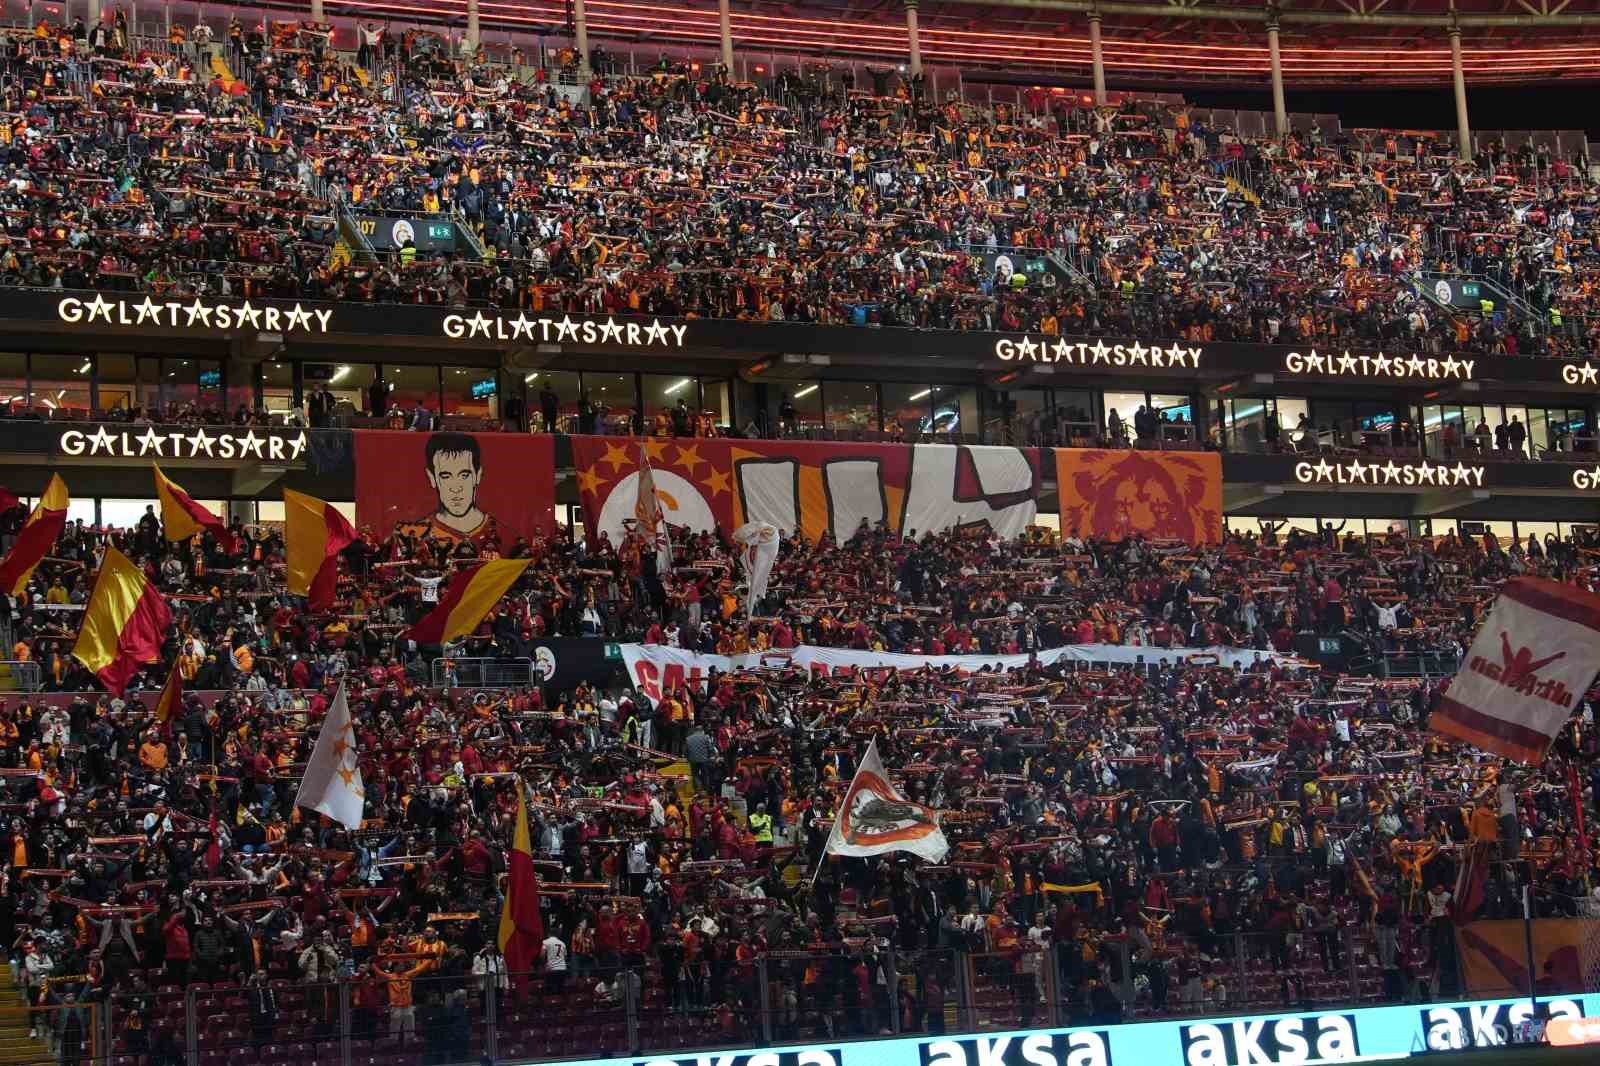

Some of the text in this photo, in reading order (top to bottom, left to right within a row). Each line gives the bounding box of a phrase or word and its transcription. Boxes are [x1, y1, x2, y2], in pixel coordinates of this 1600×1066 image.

[58, 293, 332, 333] GALATASARAY
[443, 310, 687, 347] GALATASARAY
[995, 335, 1202, 368] GALATASARAY
[1286, 350, 1475, 379] GALATASARAY
[1562, 361, 1599, 385] GA
[1295, 458, 1485, 486] GALATASARAY
[927, 1031, 1107, 1066] aksa
[1187, 1014, 1356, 1066] aksa
